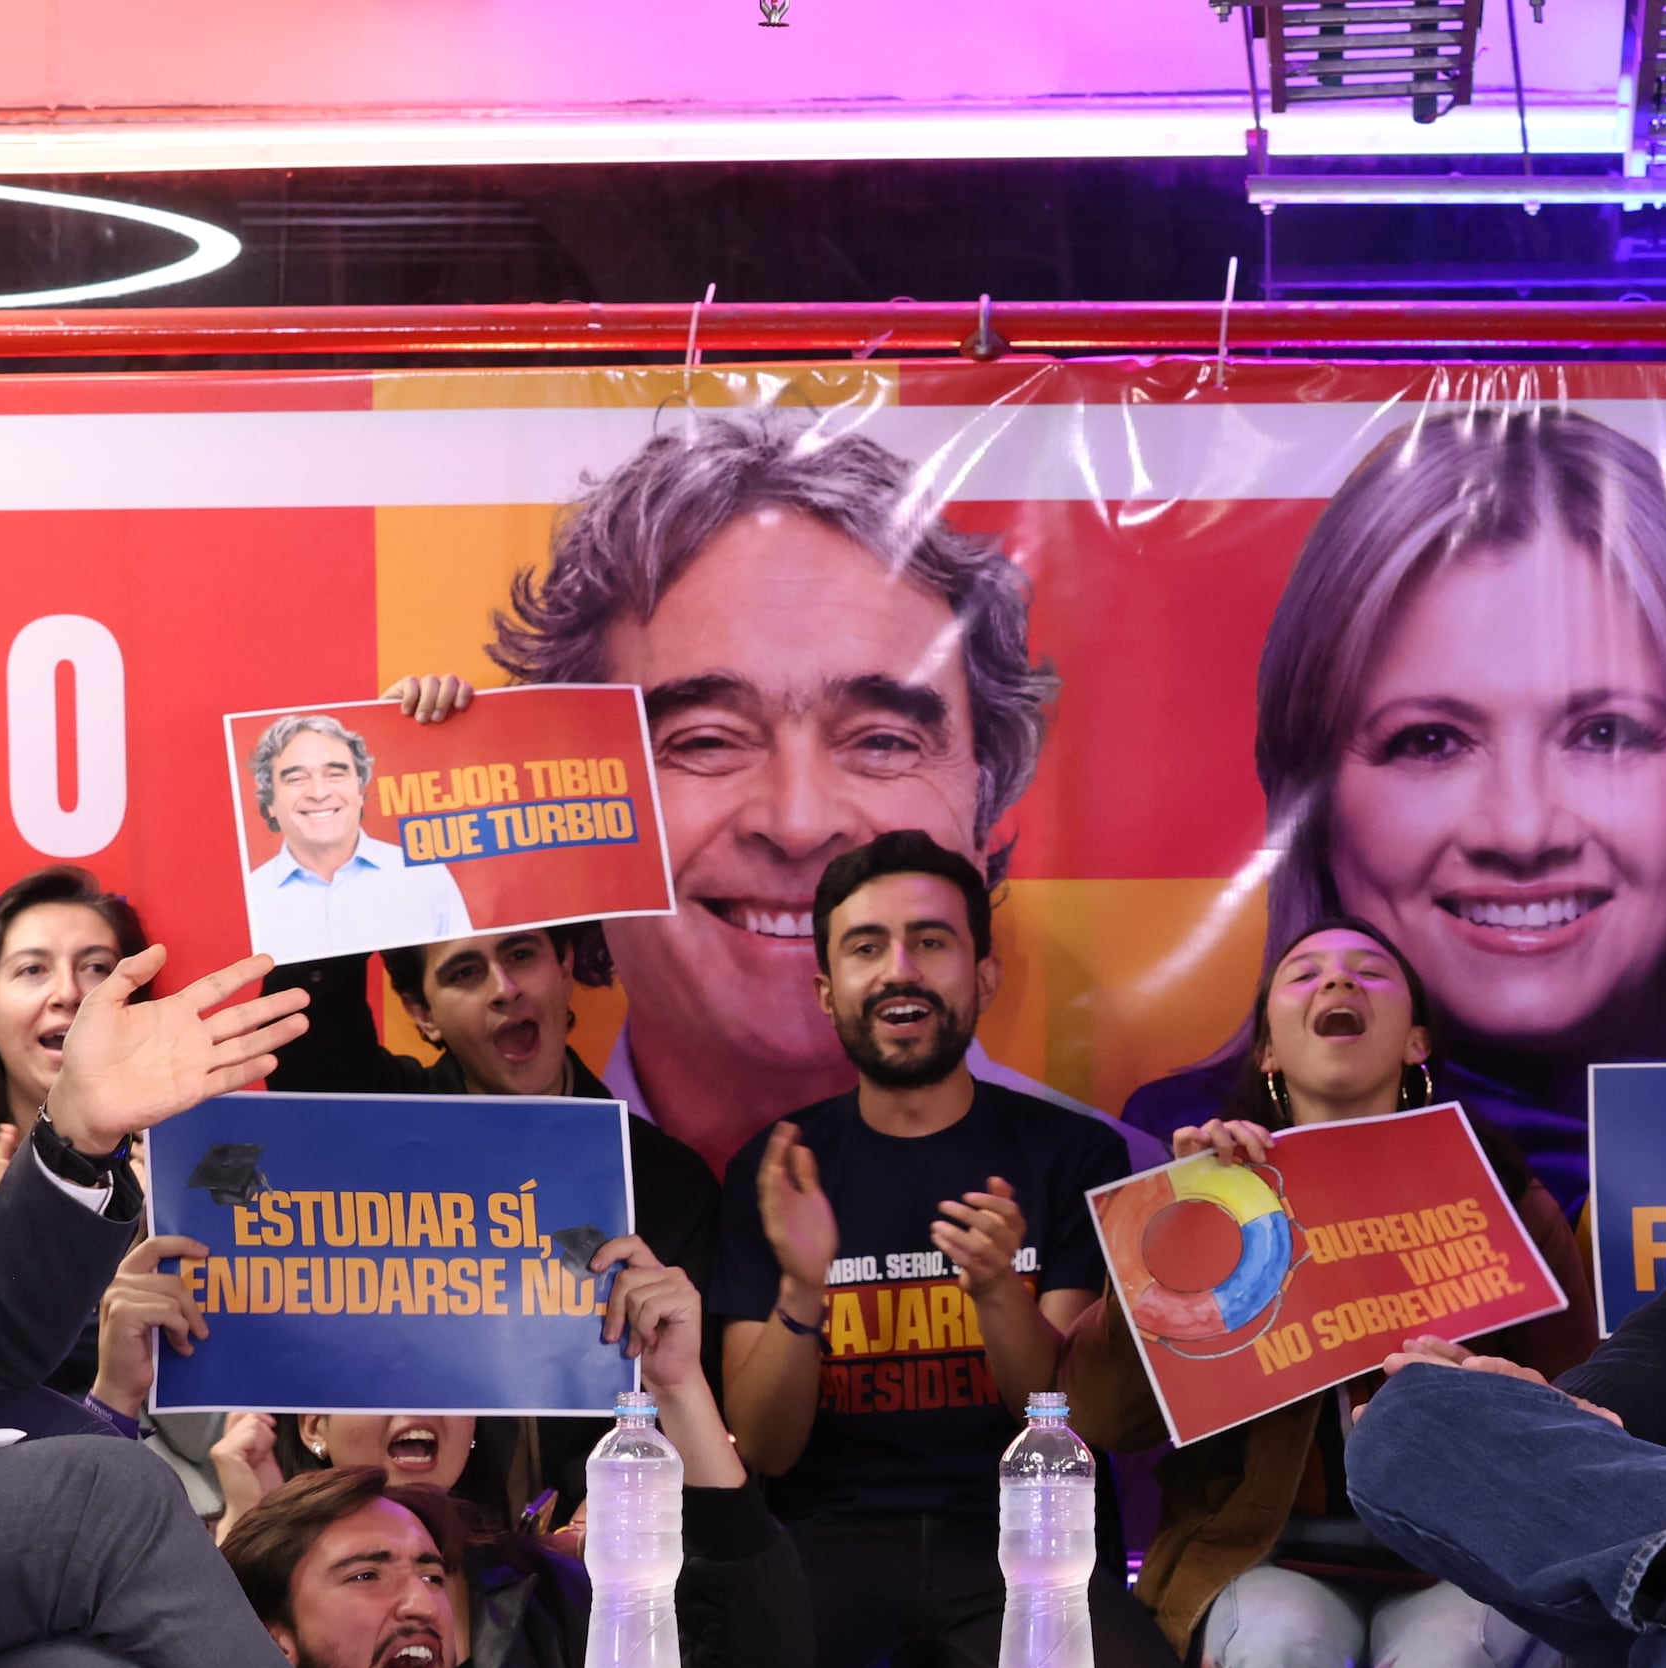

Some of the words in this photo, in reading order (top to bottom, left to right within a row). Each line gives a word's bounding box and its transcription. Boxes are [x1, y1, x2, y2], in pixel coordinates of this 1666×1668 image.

[377, 763, 520, 817] MEJOR
[523, 757, 629, 799] TIBIO
[404, 813, 483, 862] QUE
[486, 801, 634, 850] TURBIO
[234, 1190, 477, 1248] ESTUDIAR
[487, 1178, 553, 1258] SÍ,
[1304, 1197, 1489, 1265] QUEREMOS
[180, 1256, 509, 1315] ENDEUDARSE
[824, 1255, 883, 1285] MBIO.
[885, 1250, 948, 1280] SERIO.
[1398, 1234, 1511, 1287] VIVIR,
[1251, 1321, 1314, 1377] NO
[1311, 1265, 1526, 1351] SOBREVIVIR.
[819, 1356, 1000, 1416] PRESIDEN
